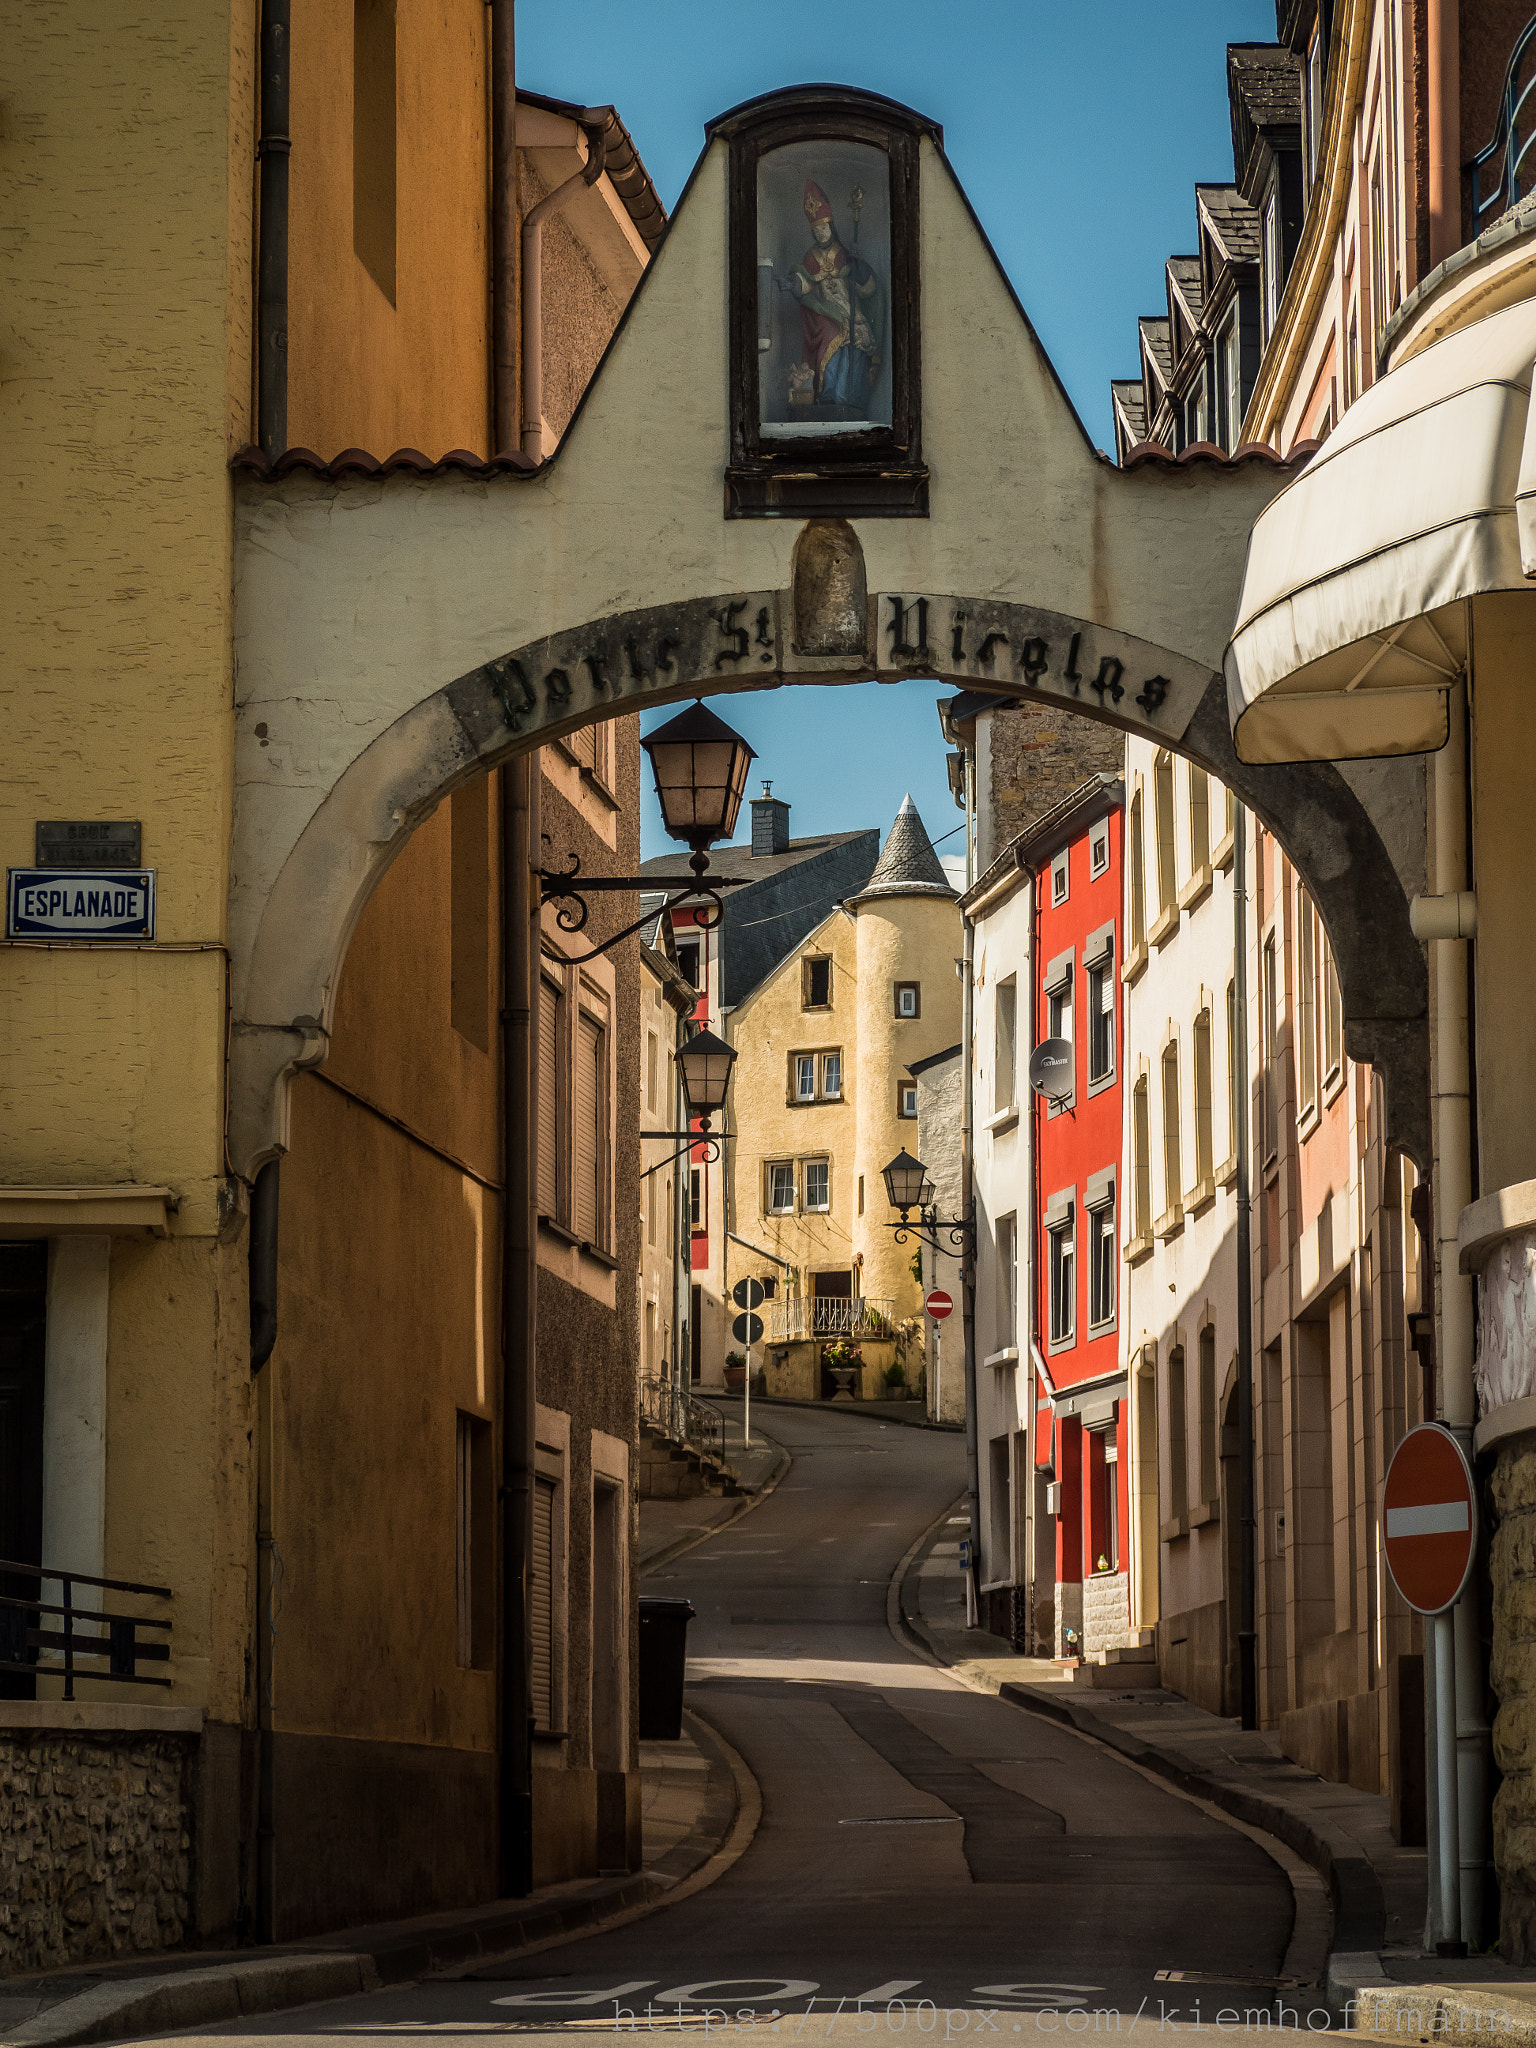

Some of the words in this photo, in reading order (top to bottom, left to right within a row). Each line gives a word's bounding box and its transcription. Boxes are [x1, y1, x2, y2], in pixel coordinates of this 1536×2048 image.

[886, 596, 1171, 715] Nicolas
[24, 890, 138, 918] ESPLANADE
[490, 1978, 1106, 2007] STOP
